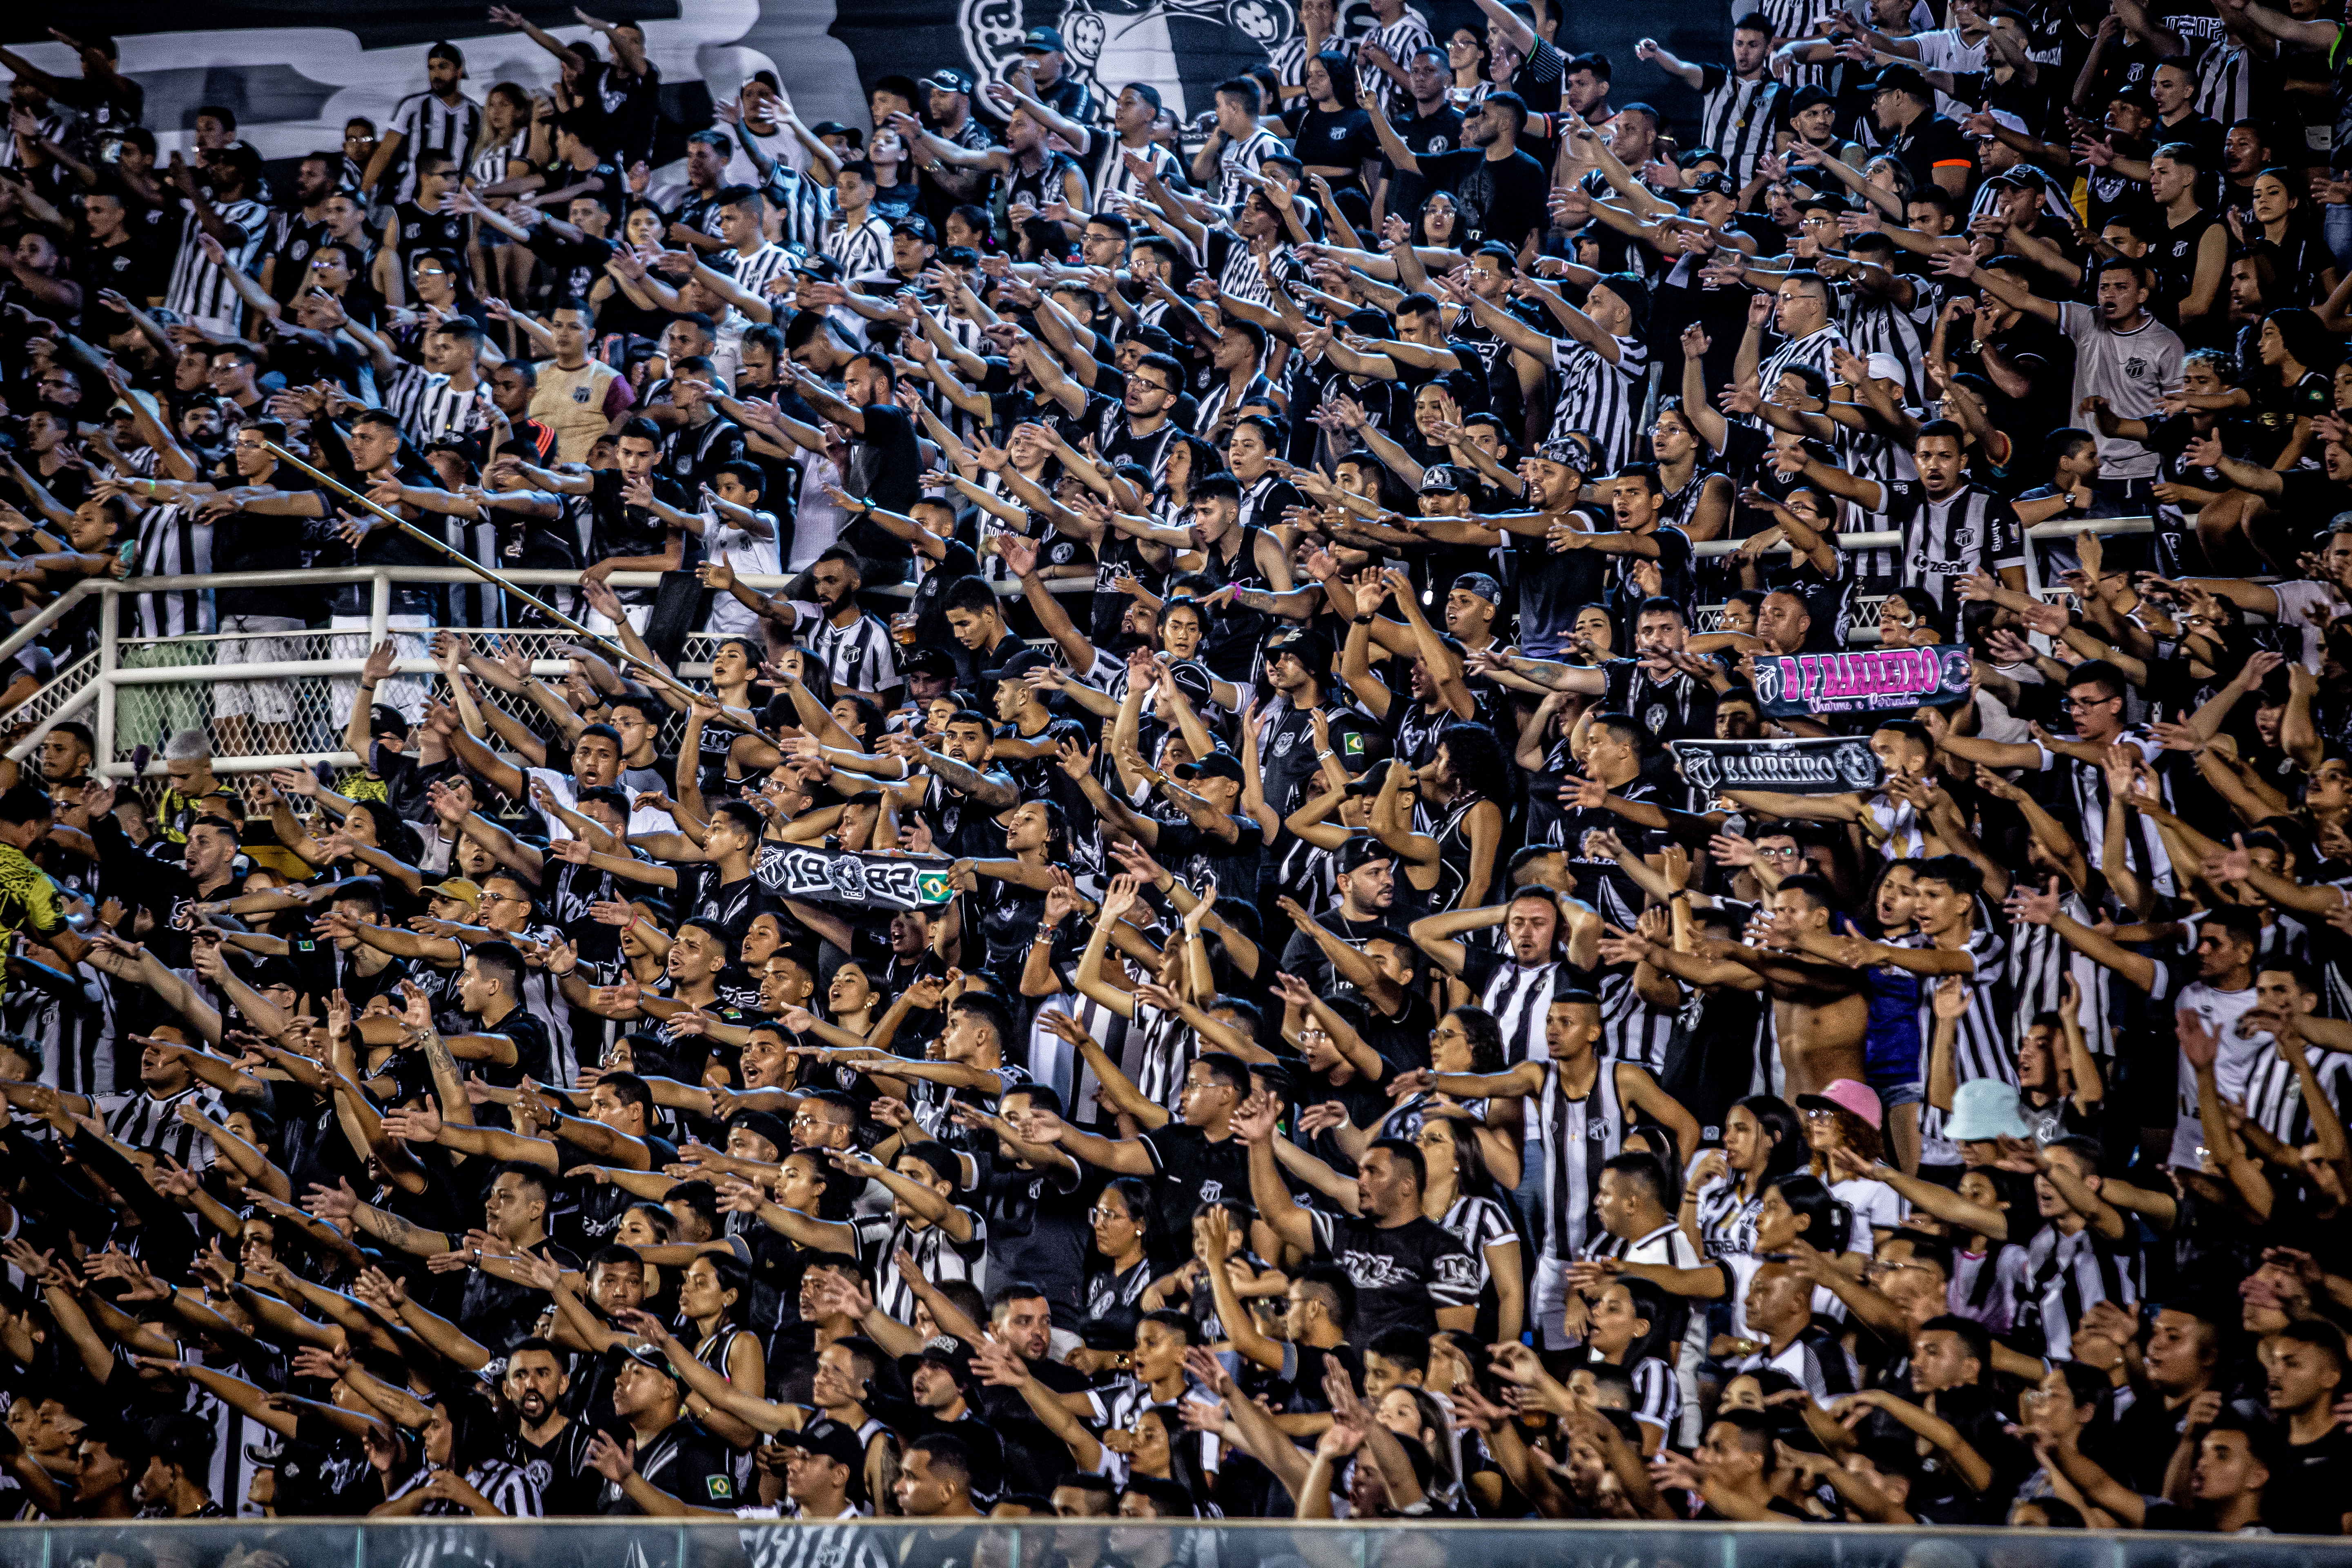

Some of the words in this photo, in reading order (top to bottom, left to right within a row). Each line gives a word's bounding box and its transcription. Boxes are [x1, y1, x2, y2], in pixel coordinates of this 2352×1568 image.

[1930, 559, 1971, 573] zenir
[1821, 648, 1940, 698] BARREIRO
[1722, 753, 1837, 783] BARREIRO
[788, 854, 830, 889] 19
[864, 868, 916, 903] 82
